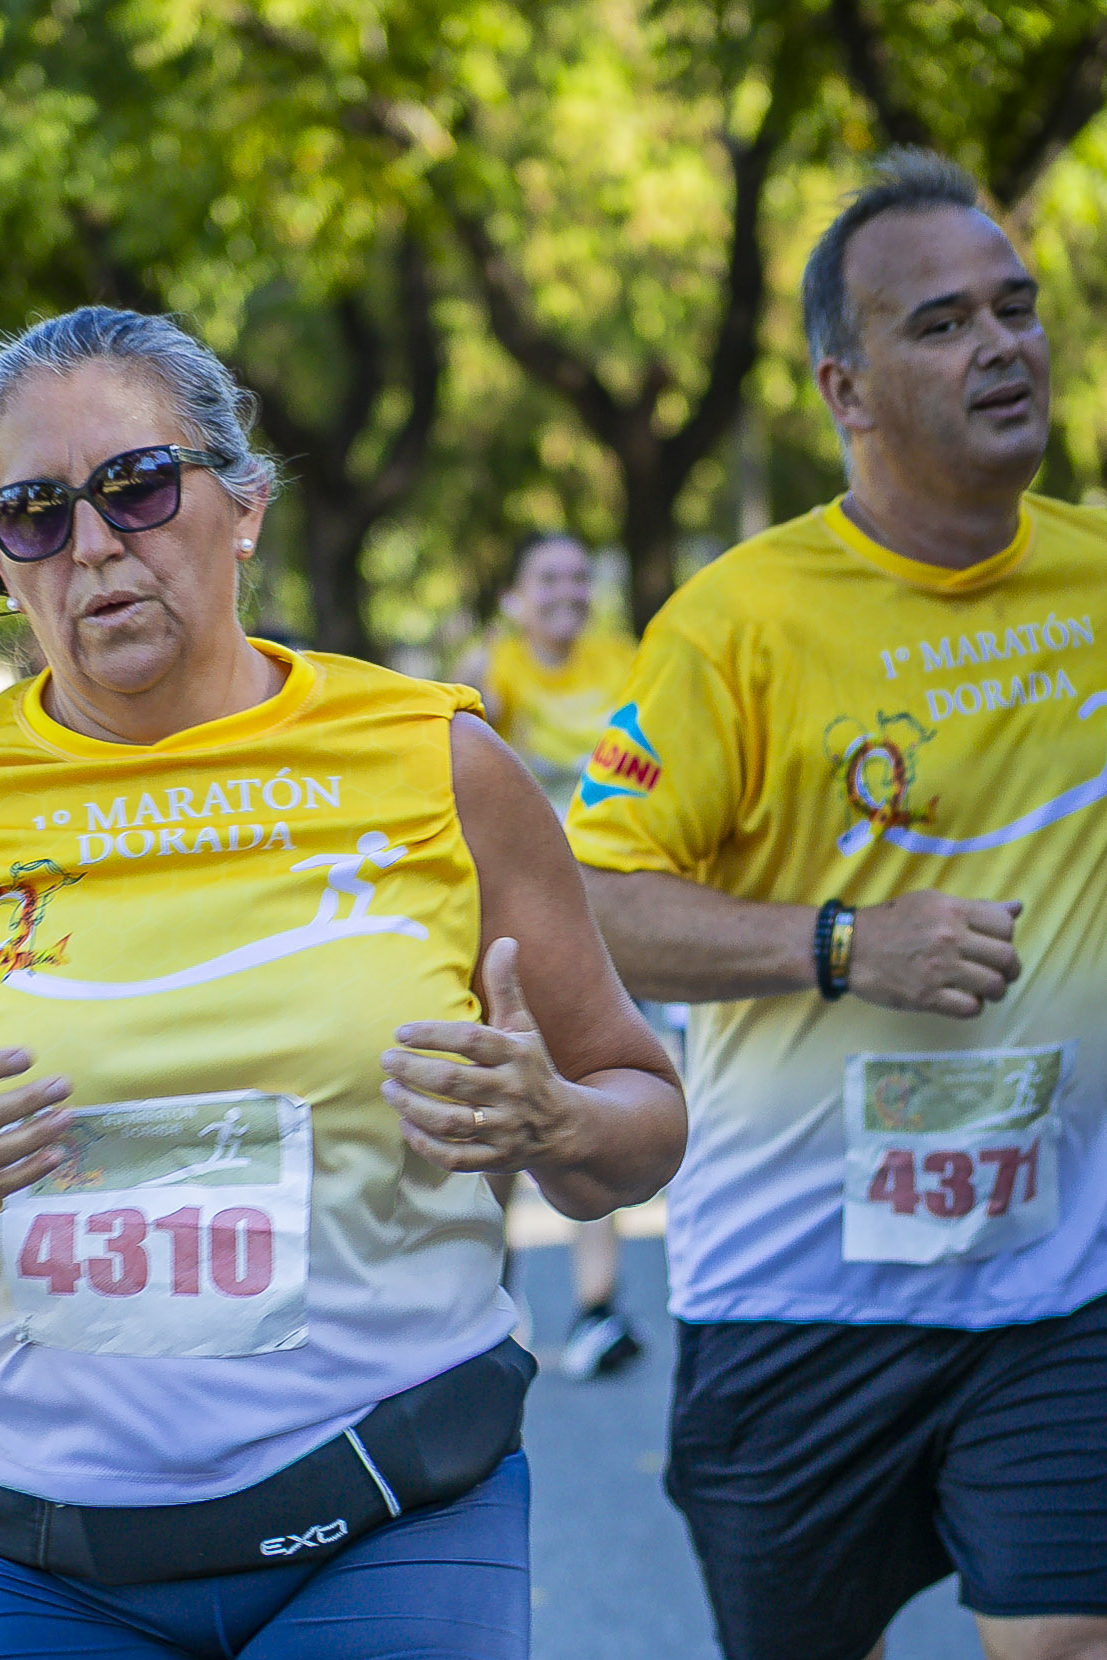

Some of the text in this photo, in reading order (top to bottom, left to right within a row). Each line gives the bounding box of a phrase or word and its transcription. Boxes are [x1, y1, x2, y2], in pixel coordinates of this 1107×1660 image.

[919, 612, 1094, 673] MARATÓN
[926, 668, 1077, 722] DORADA
[83, 767, 342, 832] MARATÓN
[75, 820, 297, 866] DORADA
[18, 1206, 275, 1298] 4310
